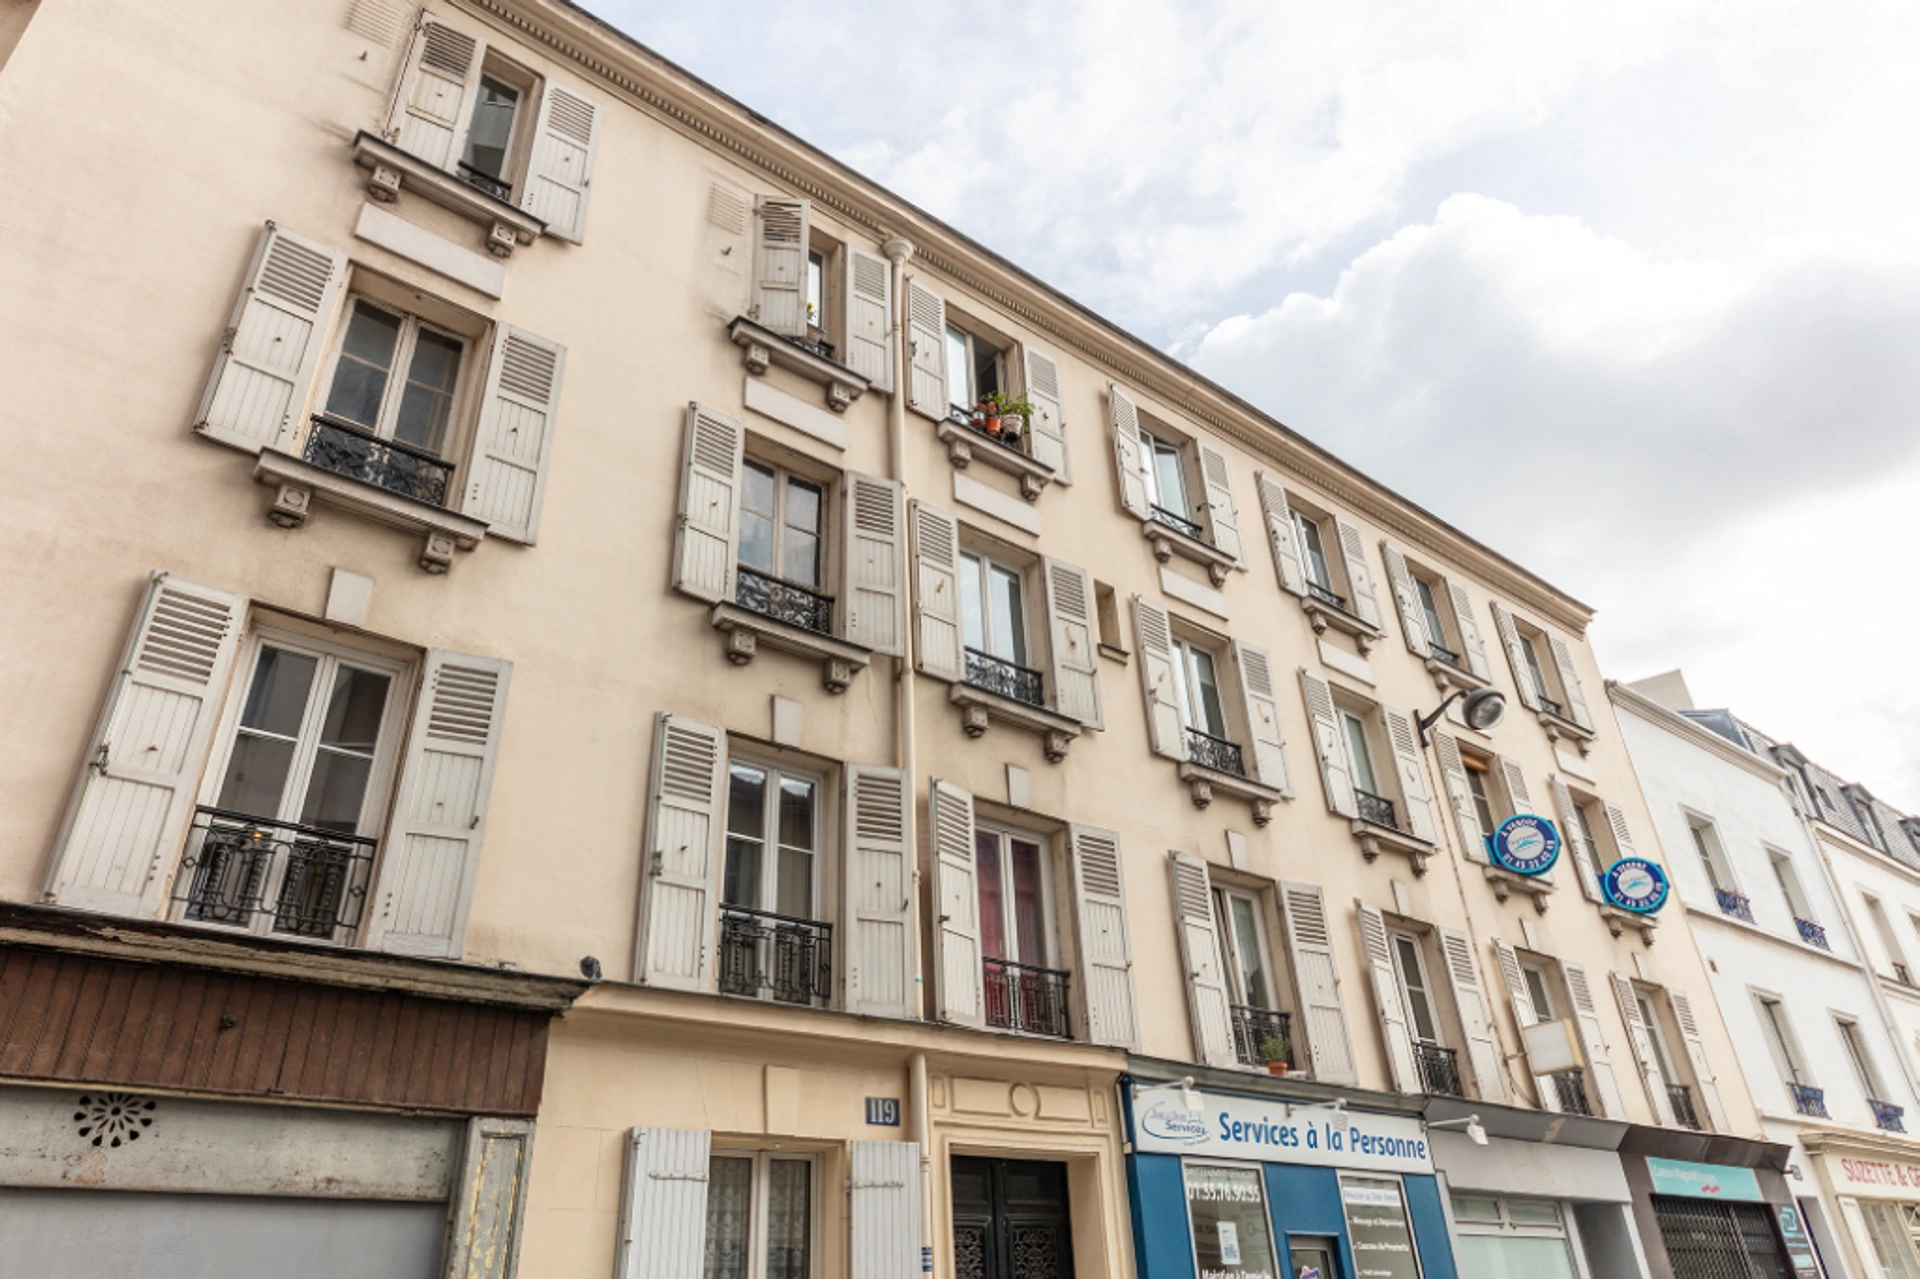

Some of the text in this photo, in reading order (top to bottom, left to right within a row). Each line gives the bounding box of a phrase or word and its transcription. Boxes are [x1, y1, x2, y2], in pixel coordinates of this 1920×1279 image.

[870, 1098, 896, 1125] 119
[1218, 1111, 1427, 1160] Services à la Personne
[1841, 1158, 1897, 1187] SUZETTE
